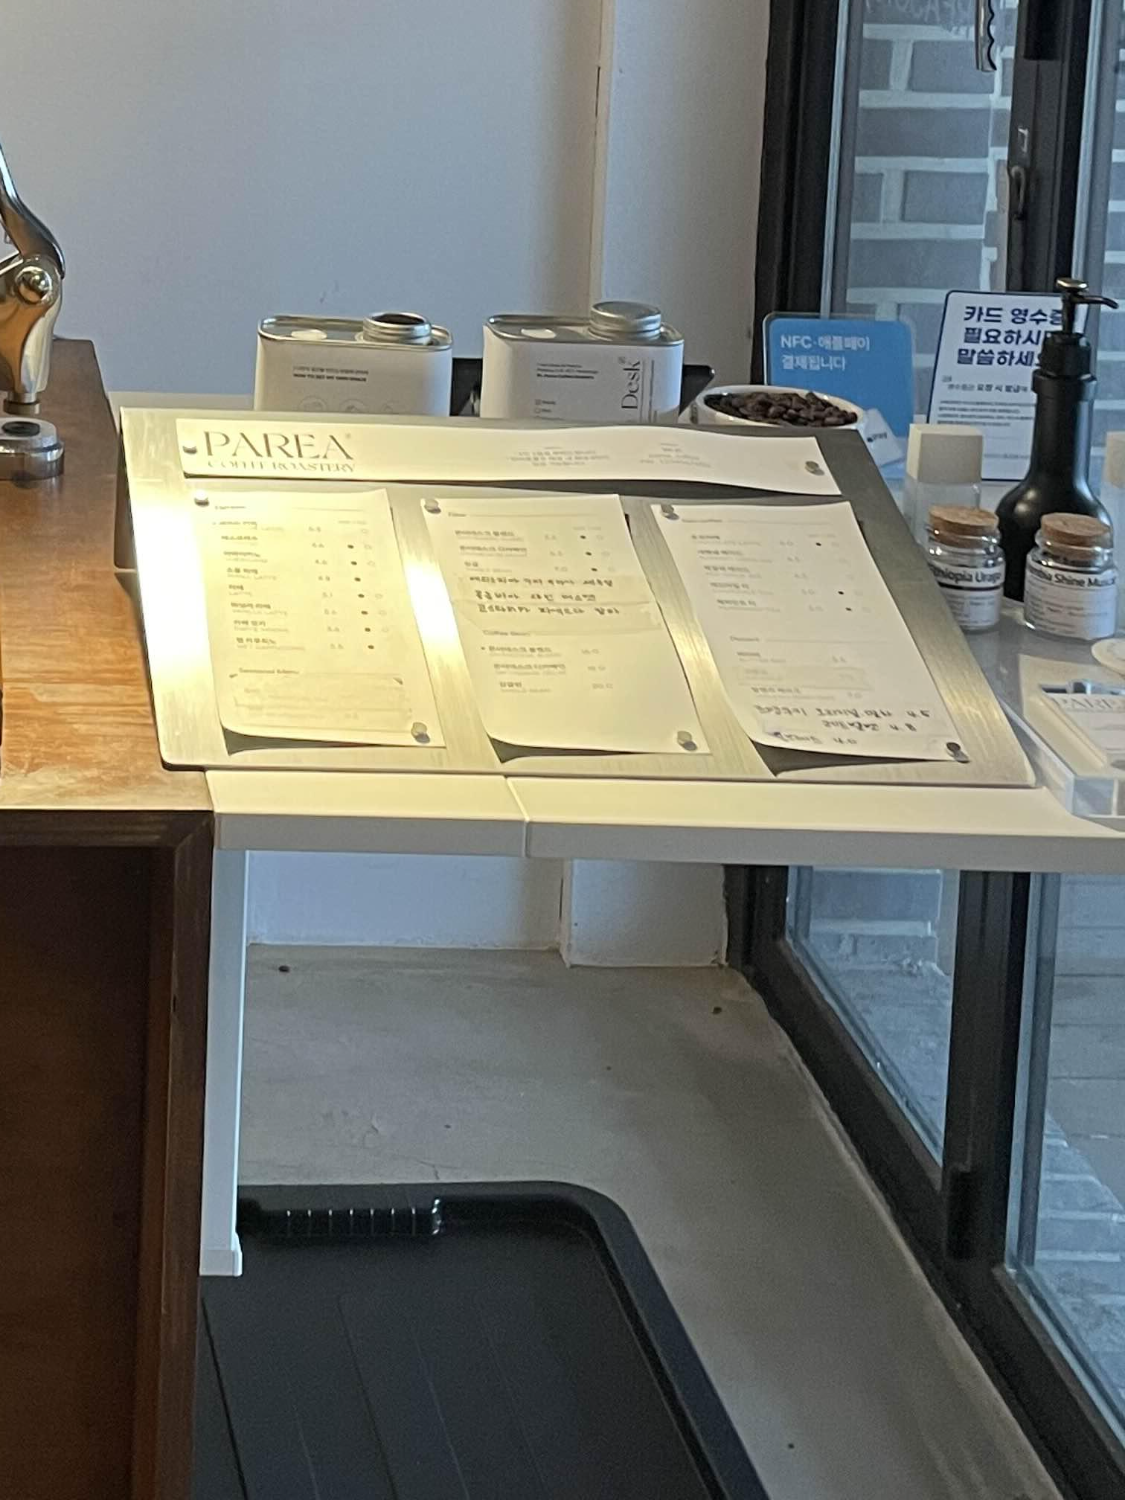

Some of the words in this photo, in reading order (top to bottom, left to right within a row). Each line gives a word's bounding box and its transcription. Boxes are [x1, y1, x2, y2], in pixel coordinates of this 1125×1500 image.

[963, 304, 1004, 324] 카드
[962, 326, 1043, 347] 필요하시
[956, 347, 1043, 368] 말씀하세
[620, 360, 642, 410] Desk
[203, 431, 354, 460] PAREA
